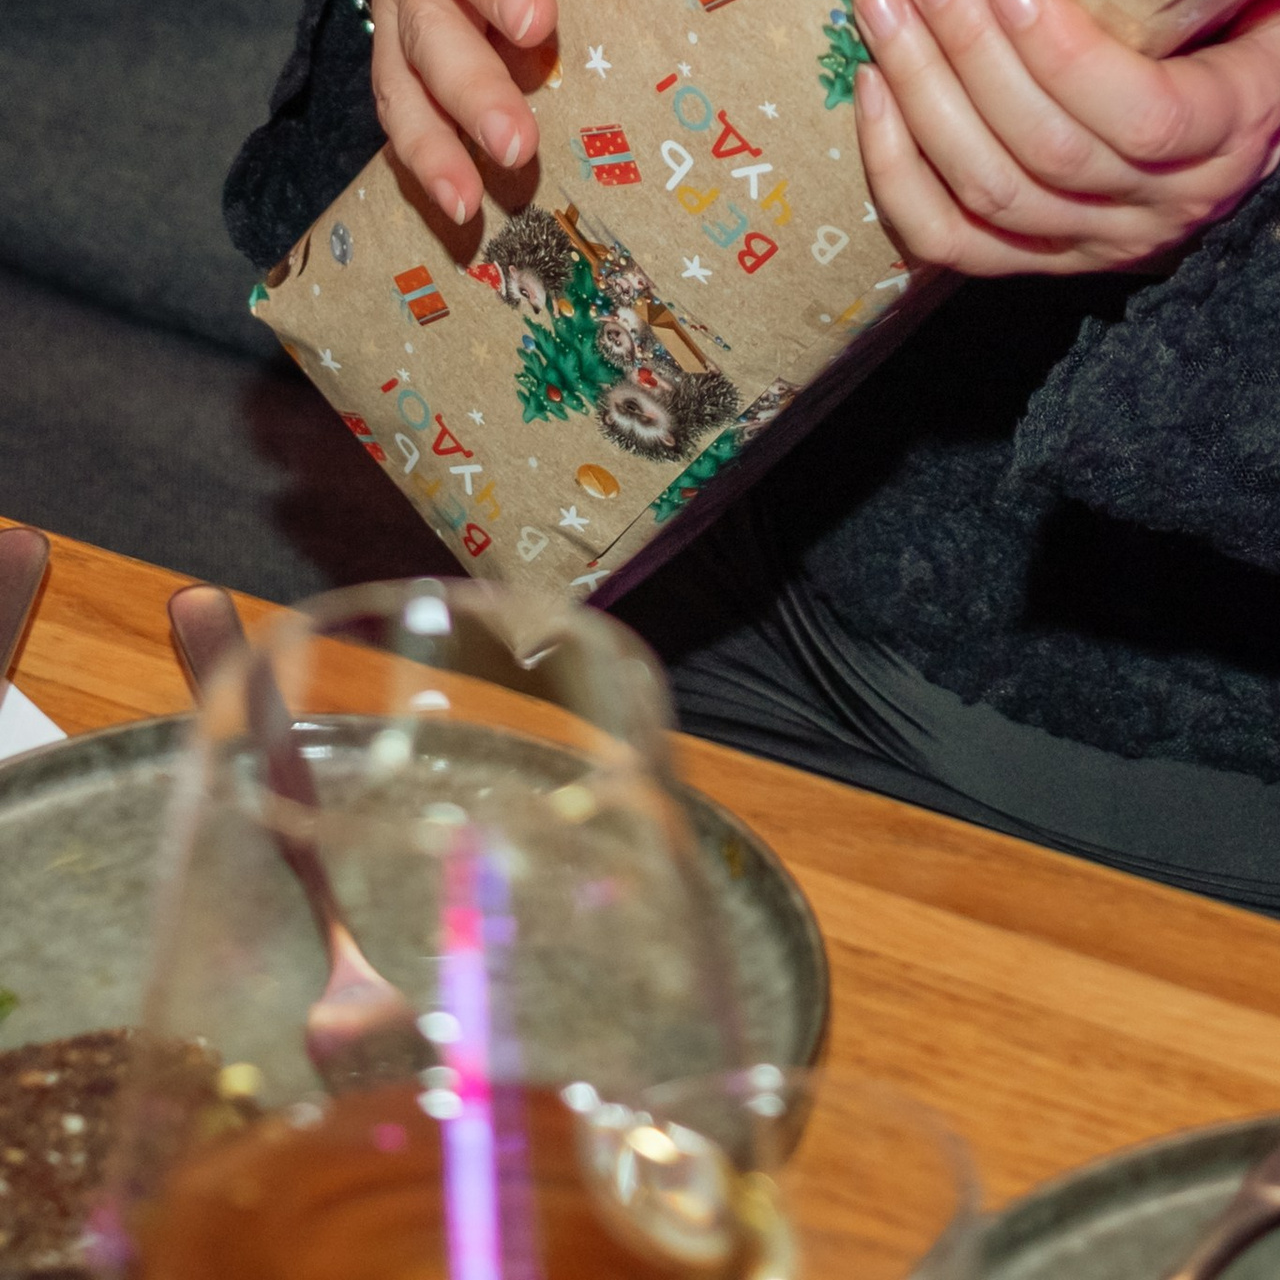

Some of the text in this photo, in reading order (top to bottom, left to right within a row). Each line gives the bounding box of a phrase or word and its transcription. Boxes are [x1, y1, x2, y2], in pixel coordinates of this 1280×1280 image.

[661, 140, 778, 274] ВЕРЬ
[811, 225, 849, 265] В
[394, 432, 492, 557] ВЕРЬ
[517, 526, 549, 562] В
